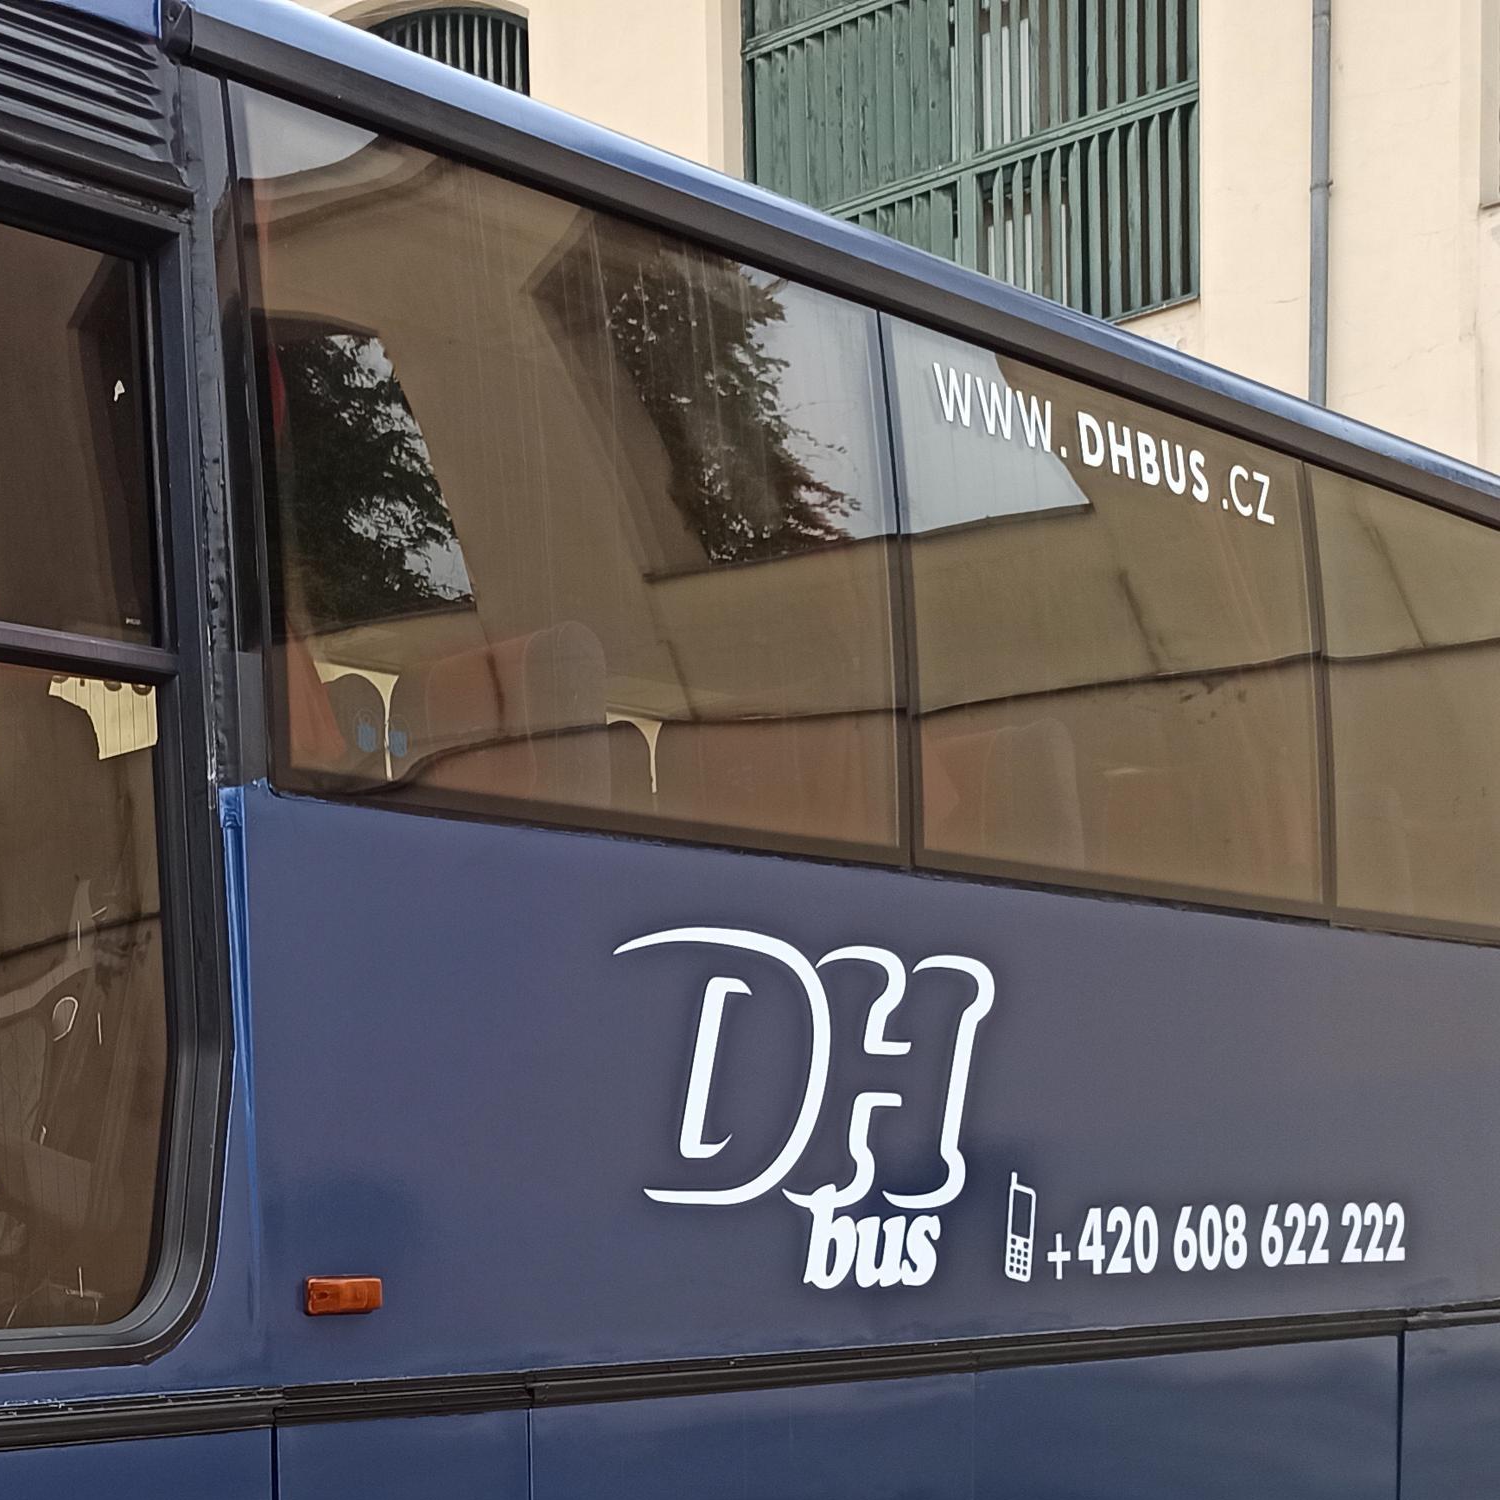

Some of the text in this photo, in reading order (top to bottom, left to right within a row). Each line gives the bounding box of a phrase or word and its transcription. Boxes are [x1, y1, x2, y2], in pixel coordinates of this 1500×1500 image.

[803, 1183, 942, 1290] bus
[1047, 1201, 1406, 1280] +420 608 622 222
